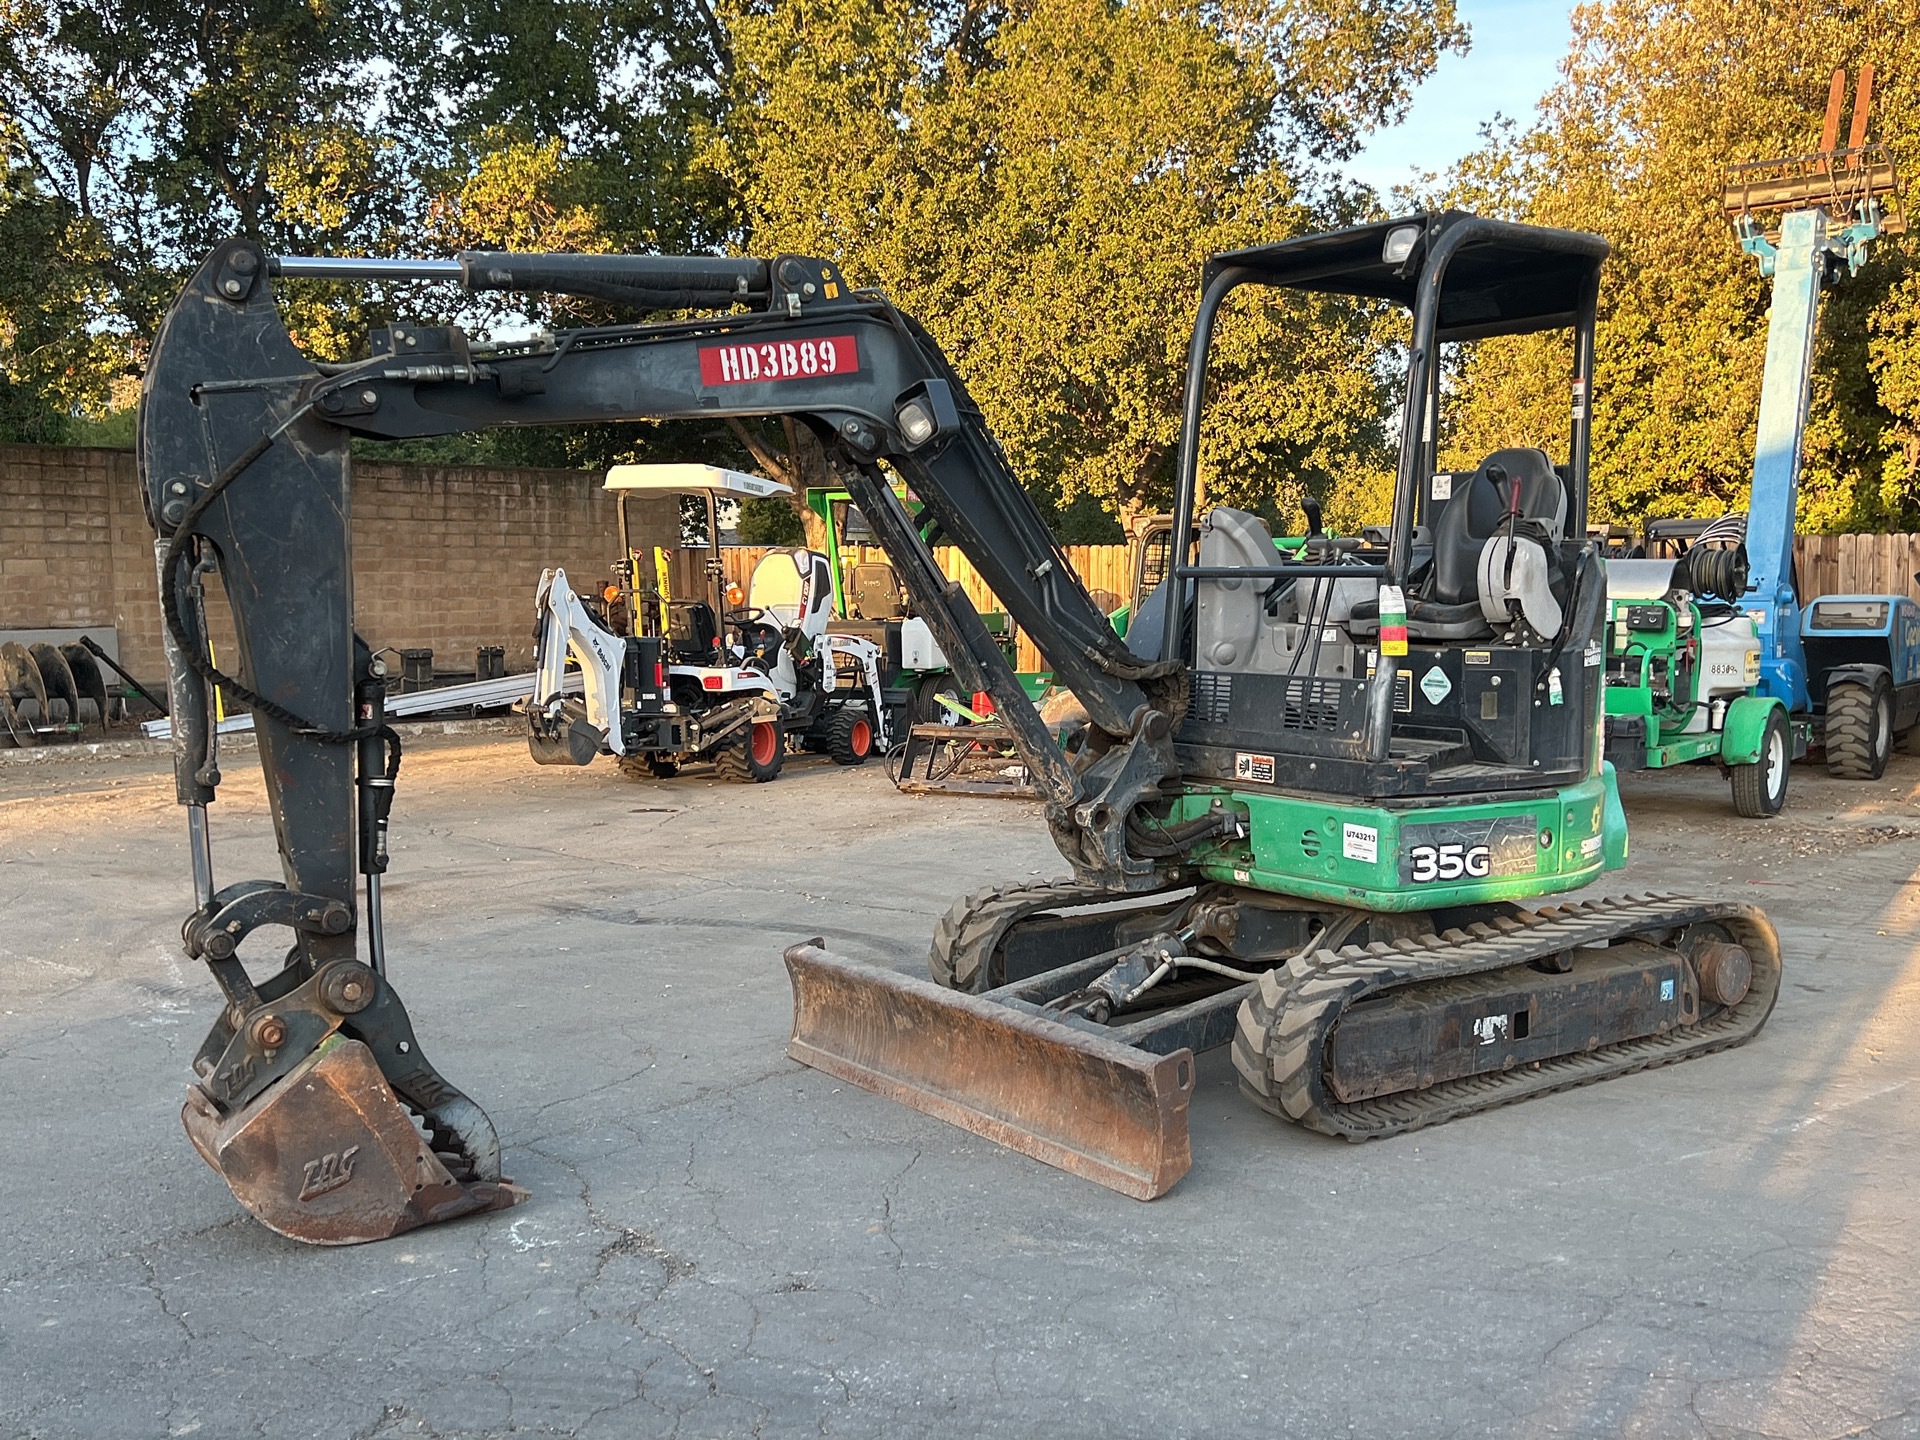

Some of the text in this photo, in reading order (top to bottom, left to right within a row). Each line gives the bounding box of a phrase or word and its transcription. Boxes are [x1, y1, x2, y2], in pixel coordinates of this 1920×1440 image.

[719, 340, 837, 382] HD3B89
[596, 647, 612, 672] Bobcat
[1346, 830, 1376, 843] U743213
[1411, 843, 1490, 882] 35G
